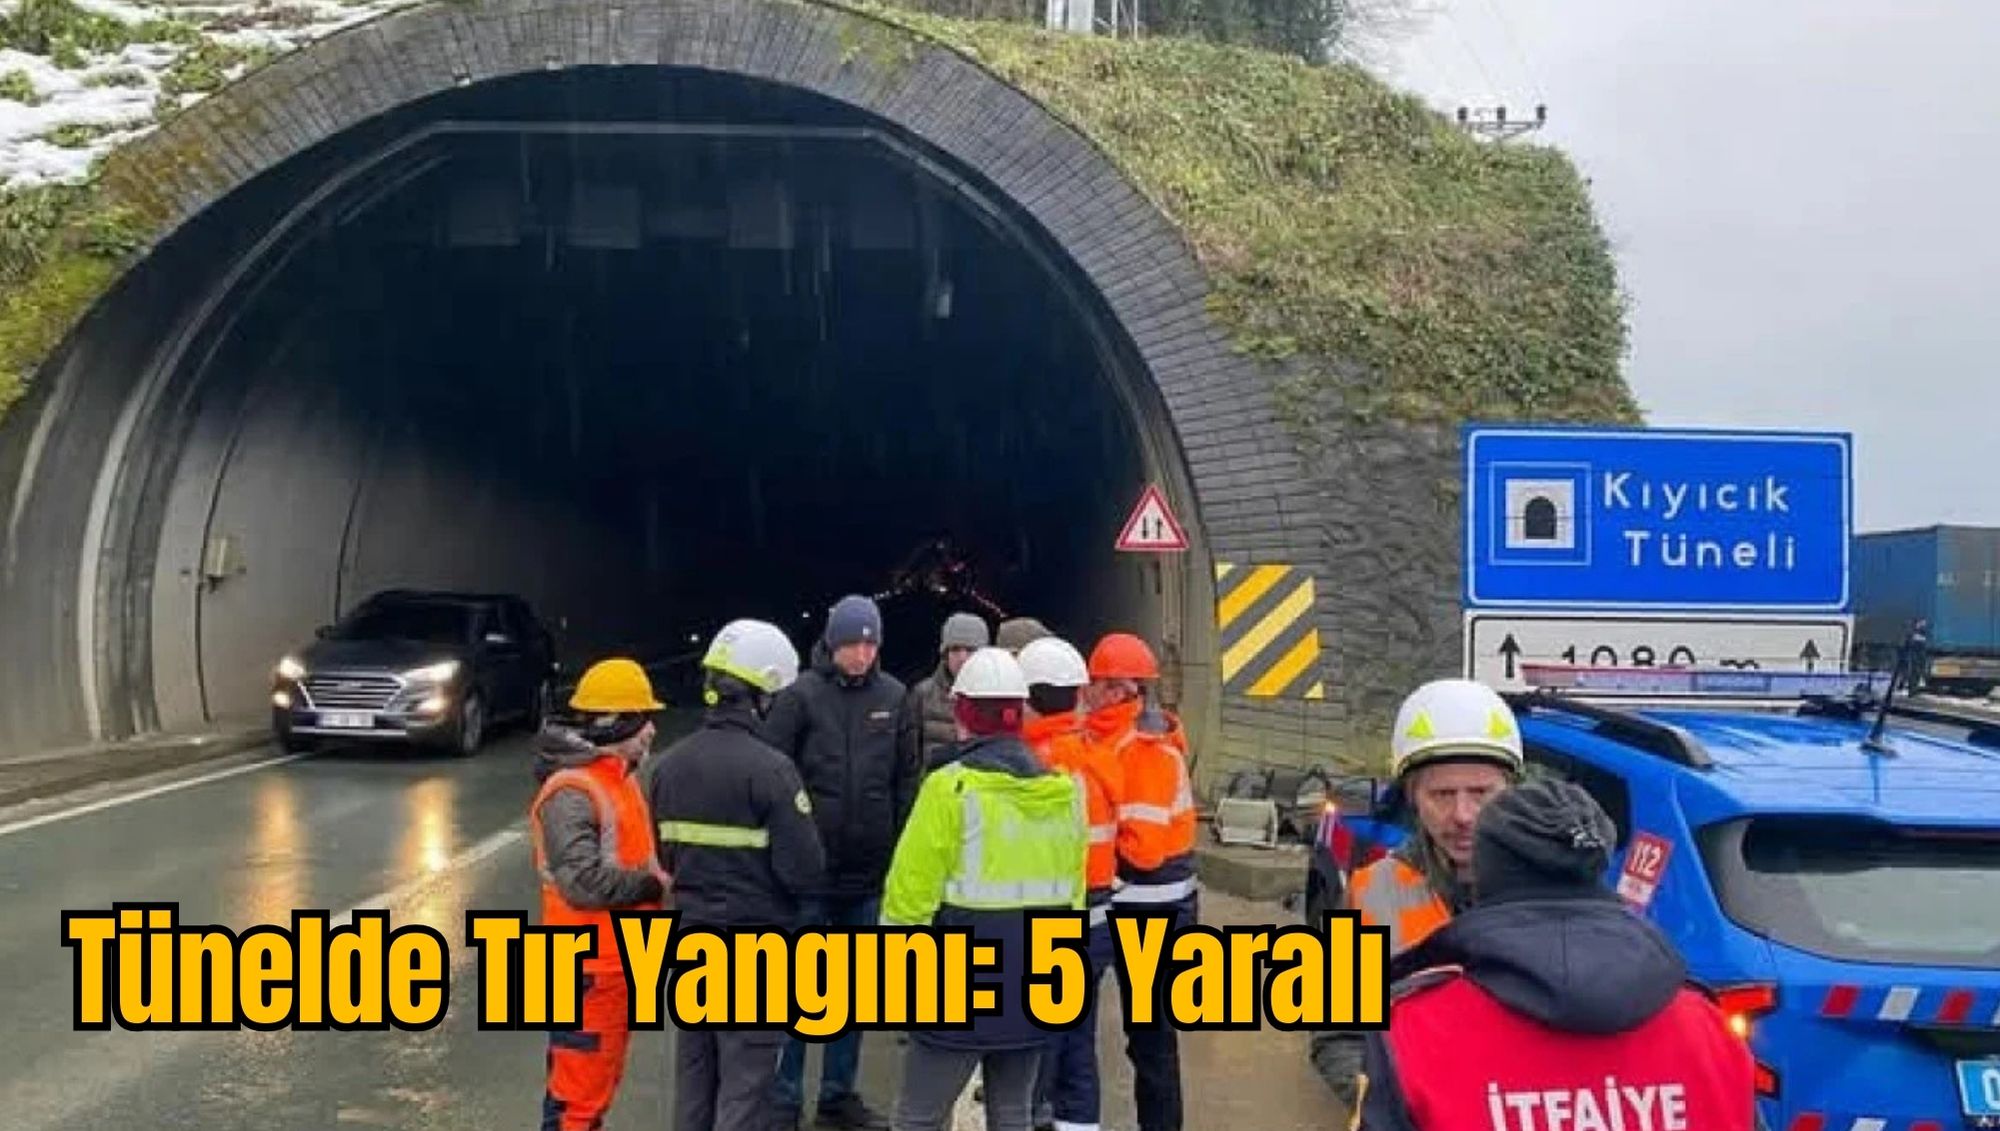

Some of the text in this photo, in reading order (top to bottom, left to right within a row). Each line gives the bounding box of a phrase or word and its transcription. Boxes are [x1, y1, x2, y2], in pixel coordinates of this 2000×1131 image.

[1603, 472, 1790, 519] Kıyıcık
[1623, 530, 1796, 570] Tüneli
[1631, 841, 1661, 877] 112
[1487, 1075, 1688, 1131] İTFAİYE
